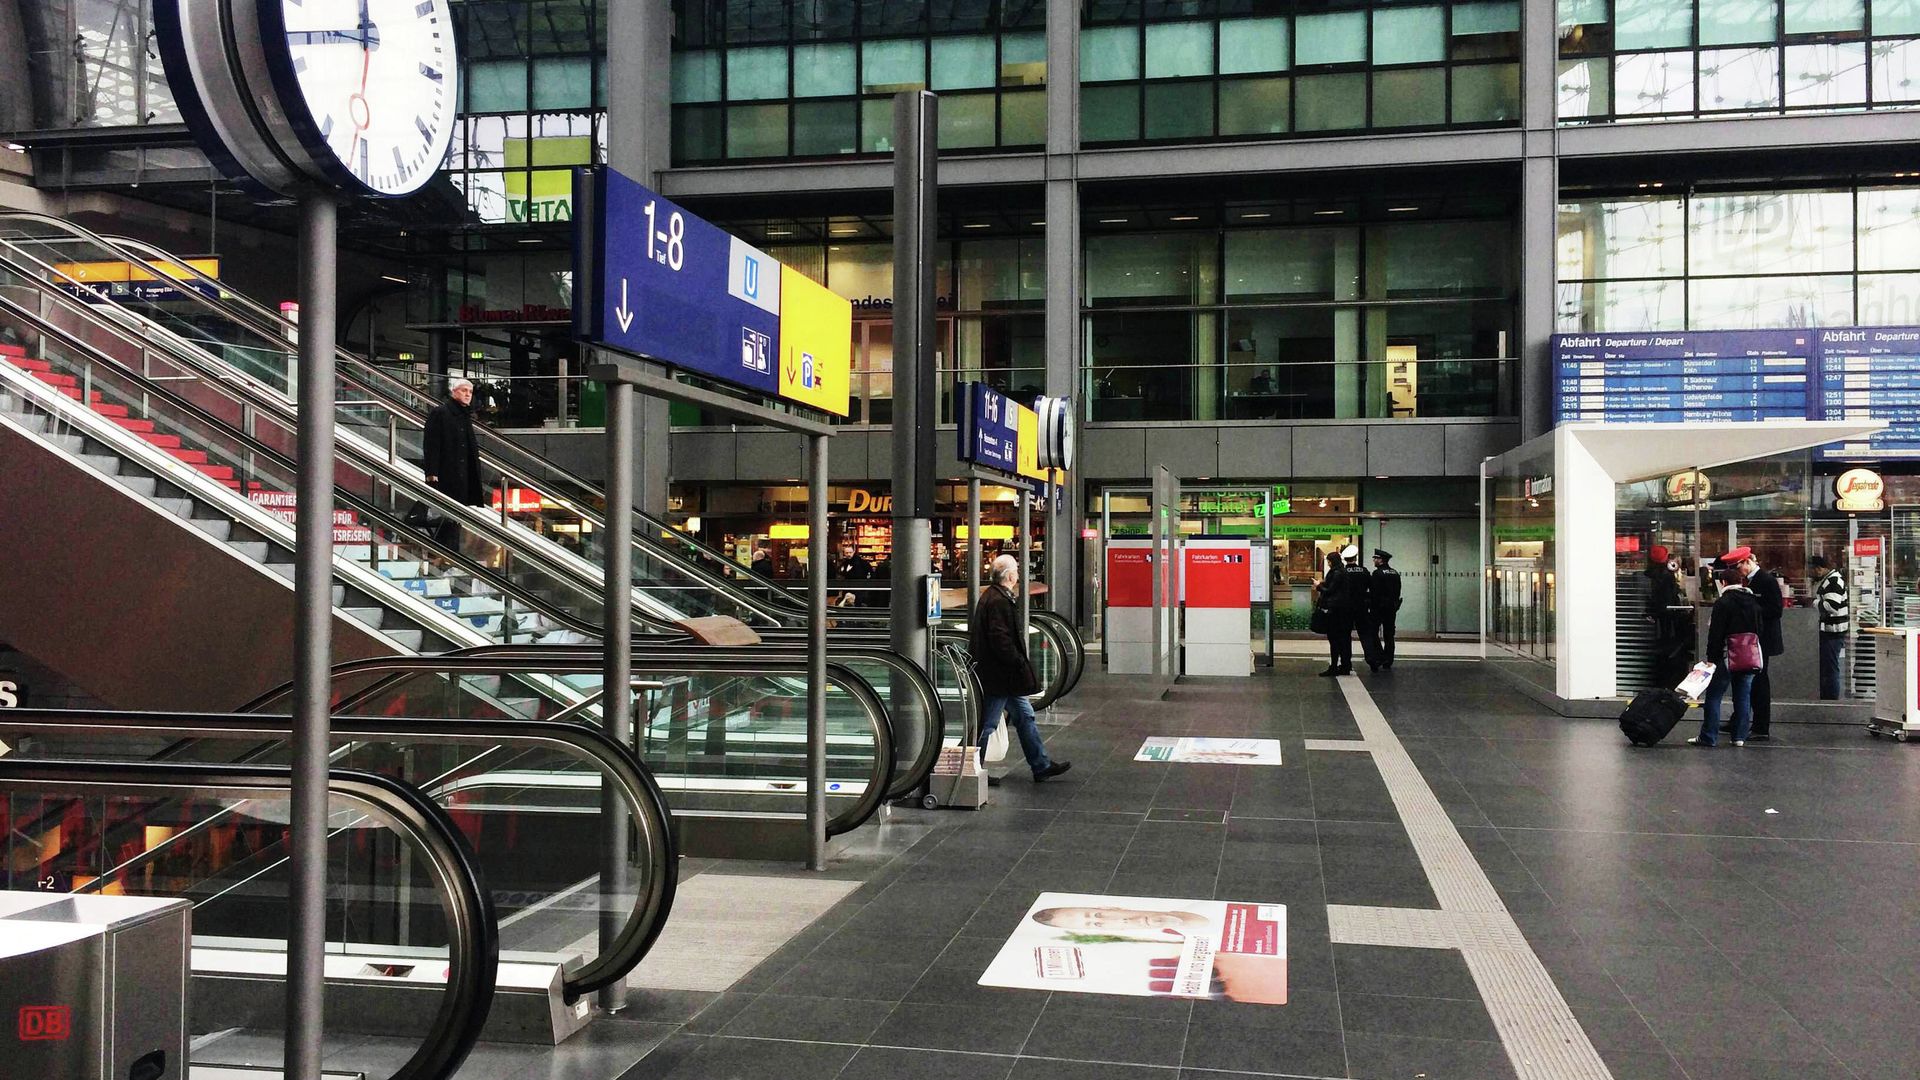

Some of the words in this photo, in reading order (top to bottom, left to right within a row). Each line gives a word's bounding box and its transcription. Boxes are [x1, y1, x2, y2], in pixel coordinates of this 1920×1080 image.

[656, 249, 667, 265] Tief
[746, 260, 756, 295] U
[116, 285, 122, 294] S
[1560, 337, 1601, 348] Abfahrt
[1605, 338, 1647, 348] Departure
[1823, 331, 1866, 342] Abfahrt
[1875, 332, 1920, 342] Departure
[24, 1009, 65, 1036] DB
